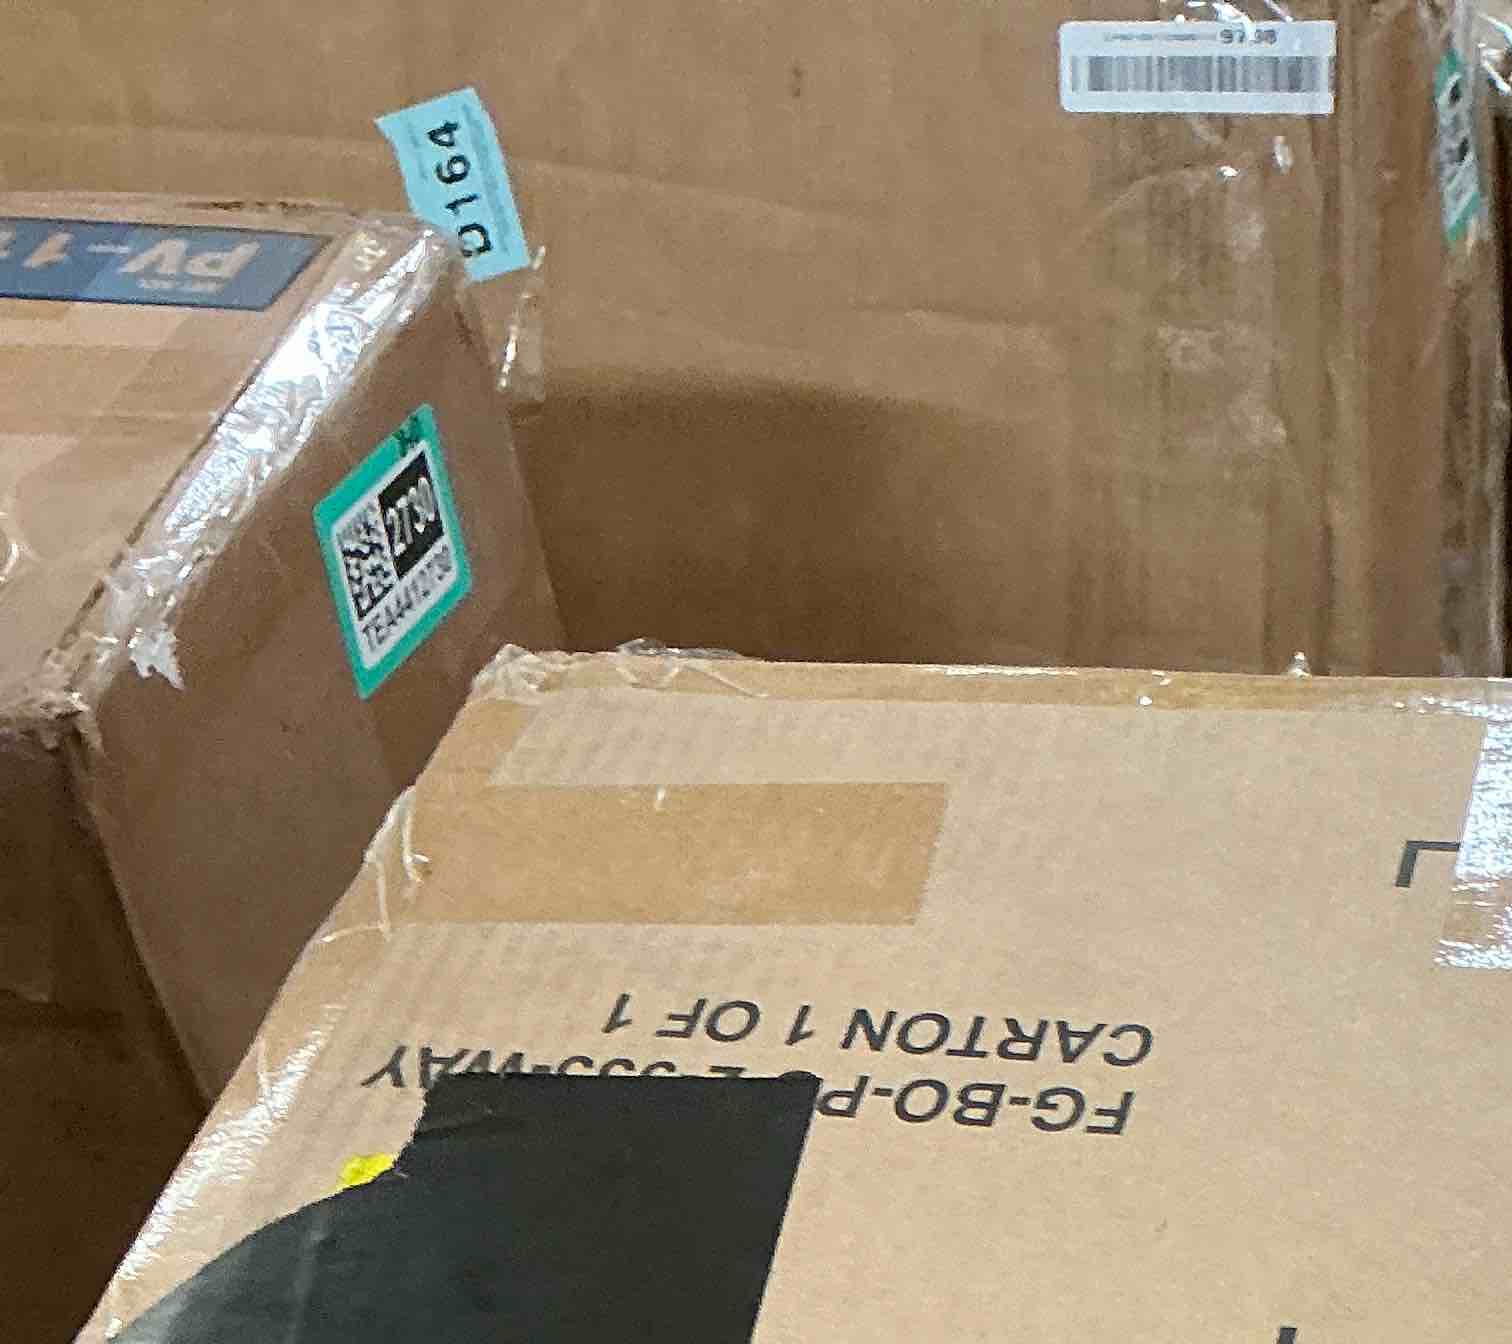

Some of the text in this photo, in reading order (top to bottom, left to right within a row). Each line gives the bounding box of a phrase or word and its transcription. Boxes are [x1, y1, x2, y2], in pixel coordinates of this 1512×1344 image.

[0, 232, 262, 279] PV-1
[601, 993, 1154, 1069] CARTON 1 OF 1
